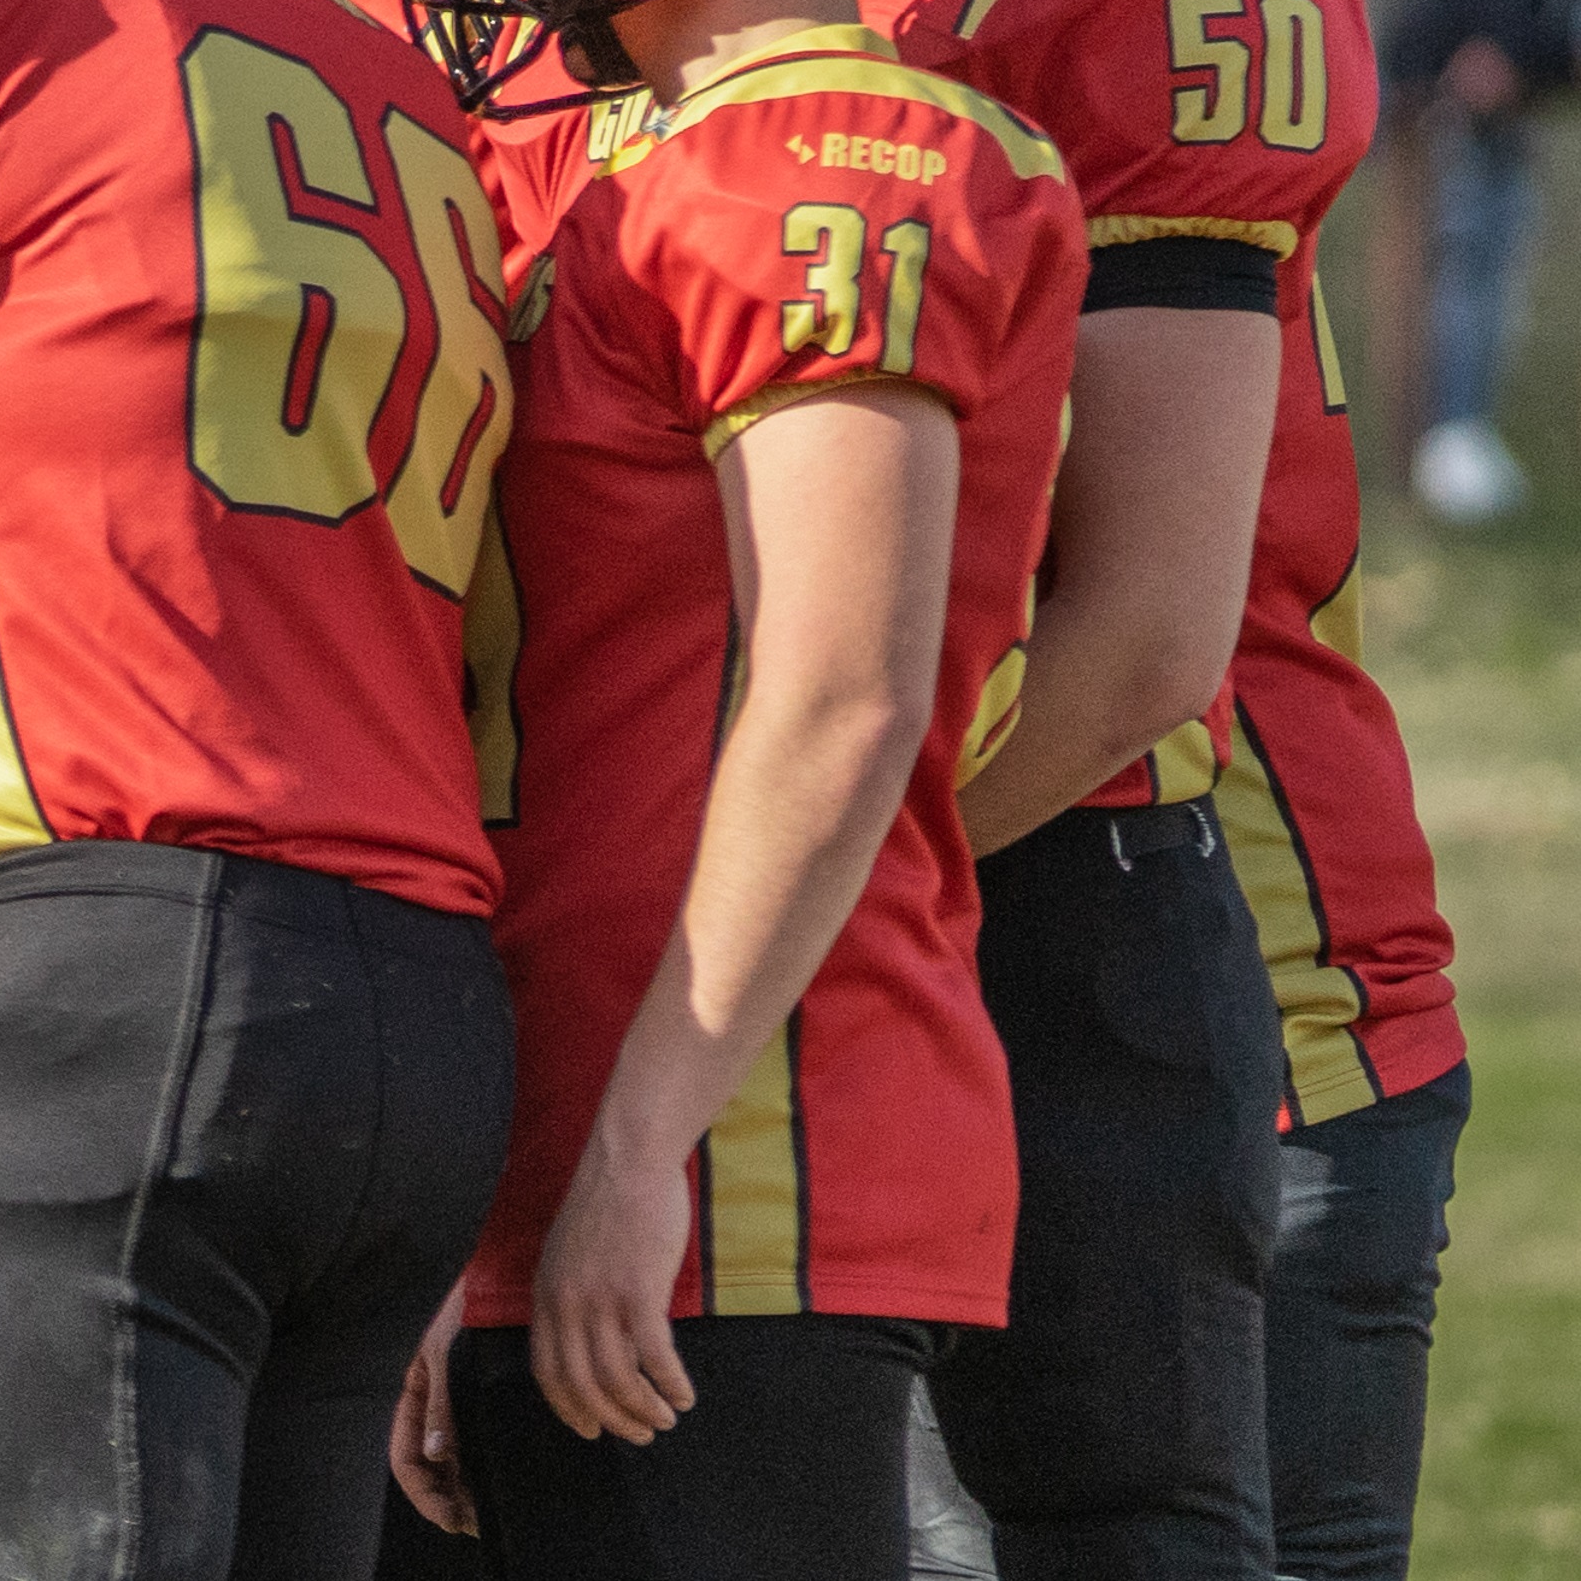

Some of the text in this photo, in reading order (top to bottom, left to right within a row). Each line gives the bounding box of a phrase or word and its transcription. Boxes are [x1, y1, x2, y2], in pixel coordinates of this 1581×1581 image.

[819, 132, 948, 186] RECOP
[178, 23, 515, 604] 66
[781, 201, 931, 375] 31
